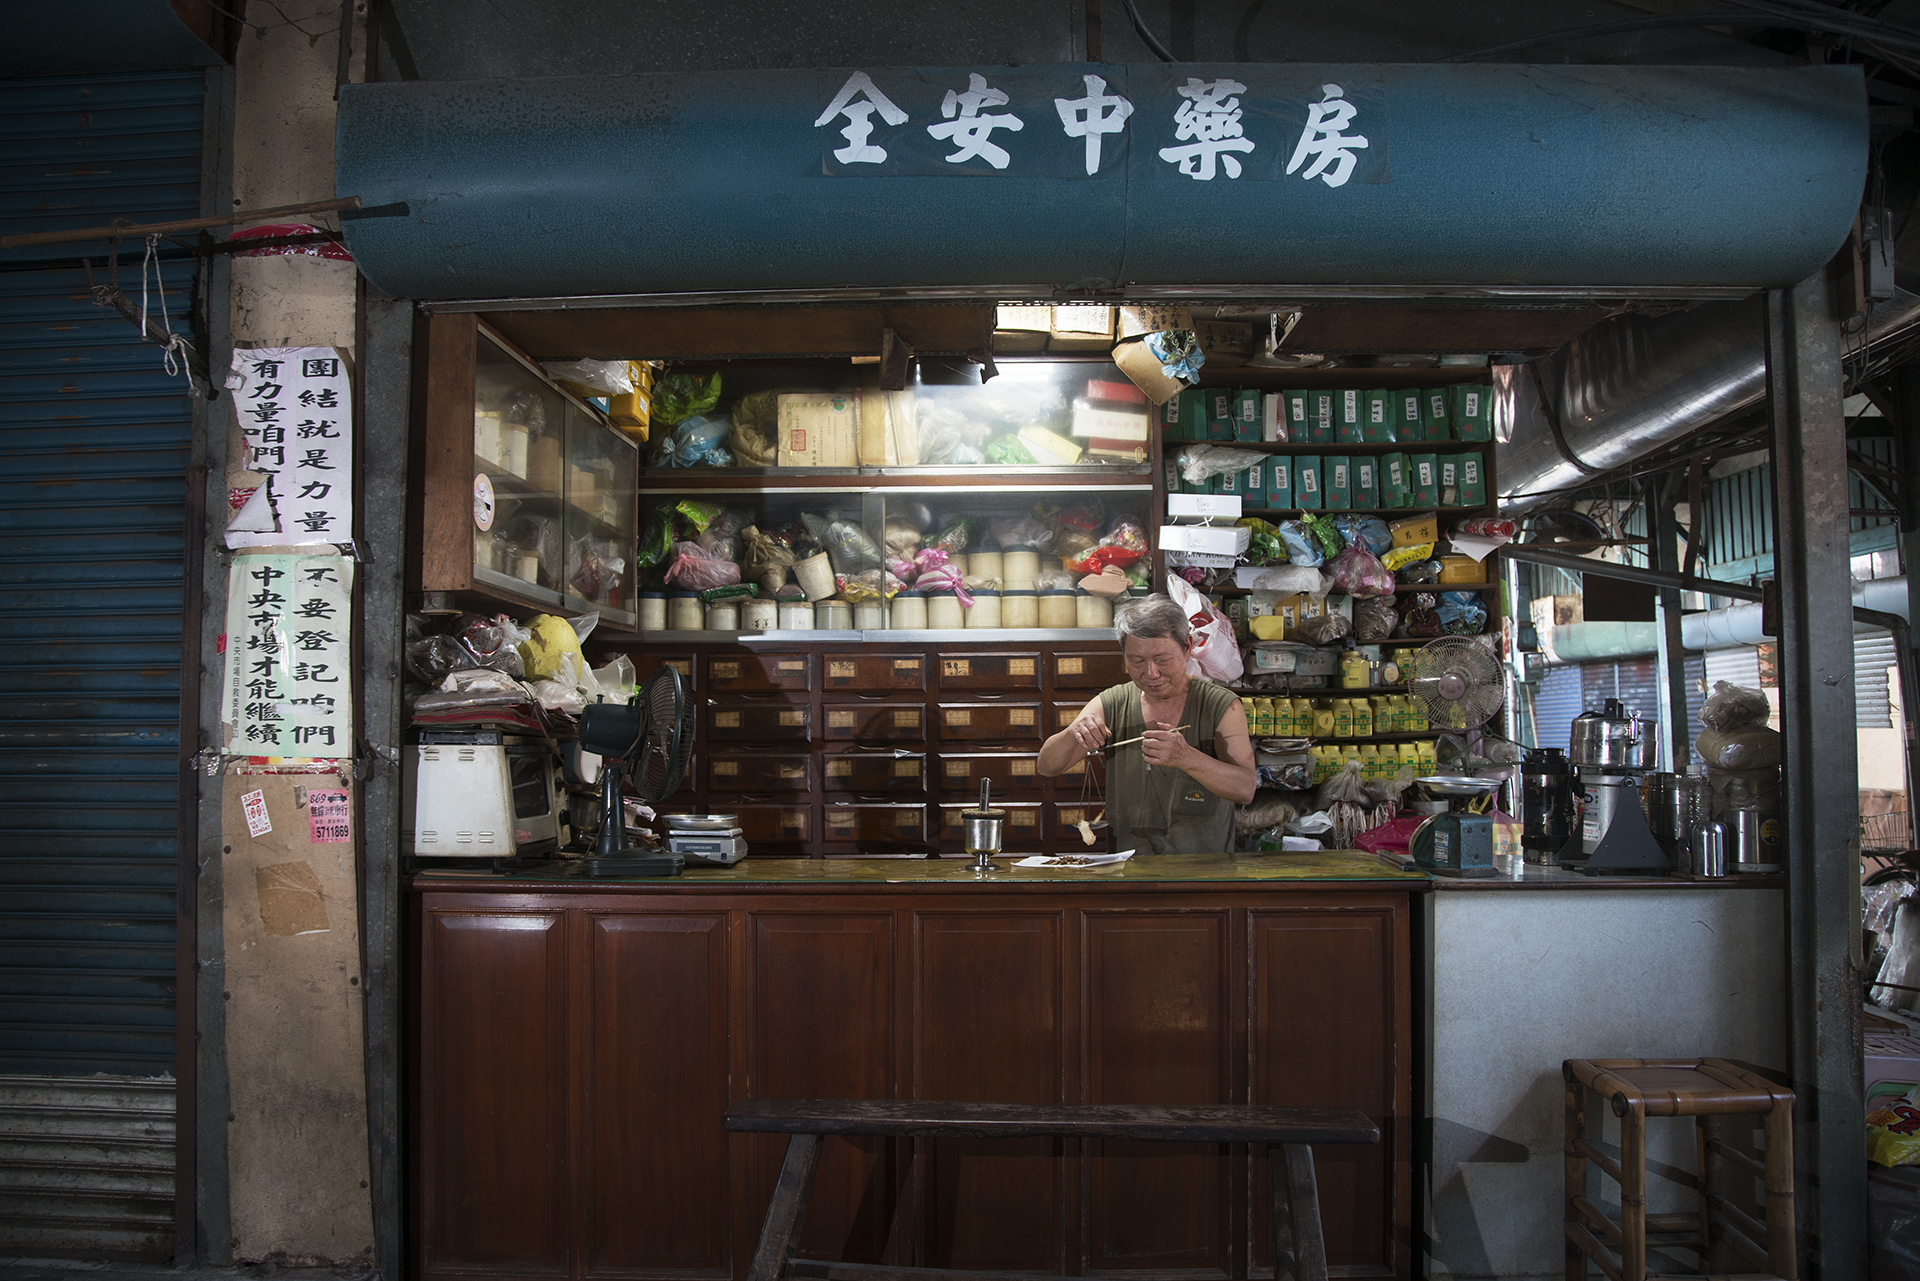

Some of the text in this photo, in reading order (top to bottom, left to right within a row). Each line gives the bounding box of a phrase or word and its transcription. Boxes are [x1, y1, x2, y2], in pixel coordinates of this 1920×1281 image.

[814, 70, 1369, 188] 全安中藥房
[294, 358, 341, 533] 團結就是力量
[245, 566, 287, 745] 中央市場才能繼續
[316, 825, 349, 838] 5711869
